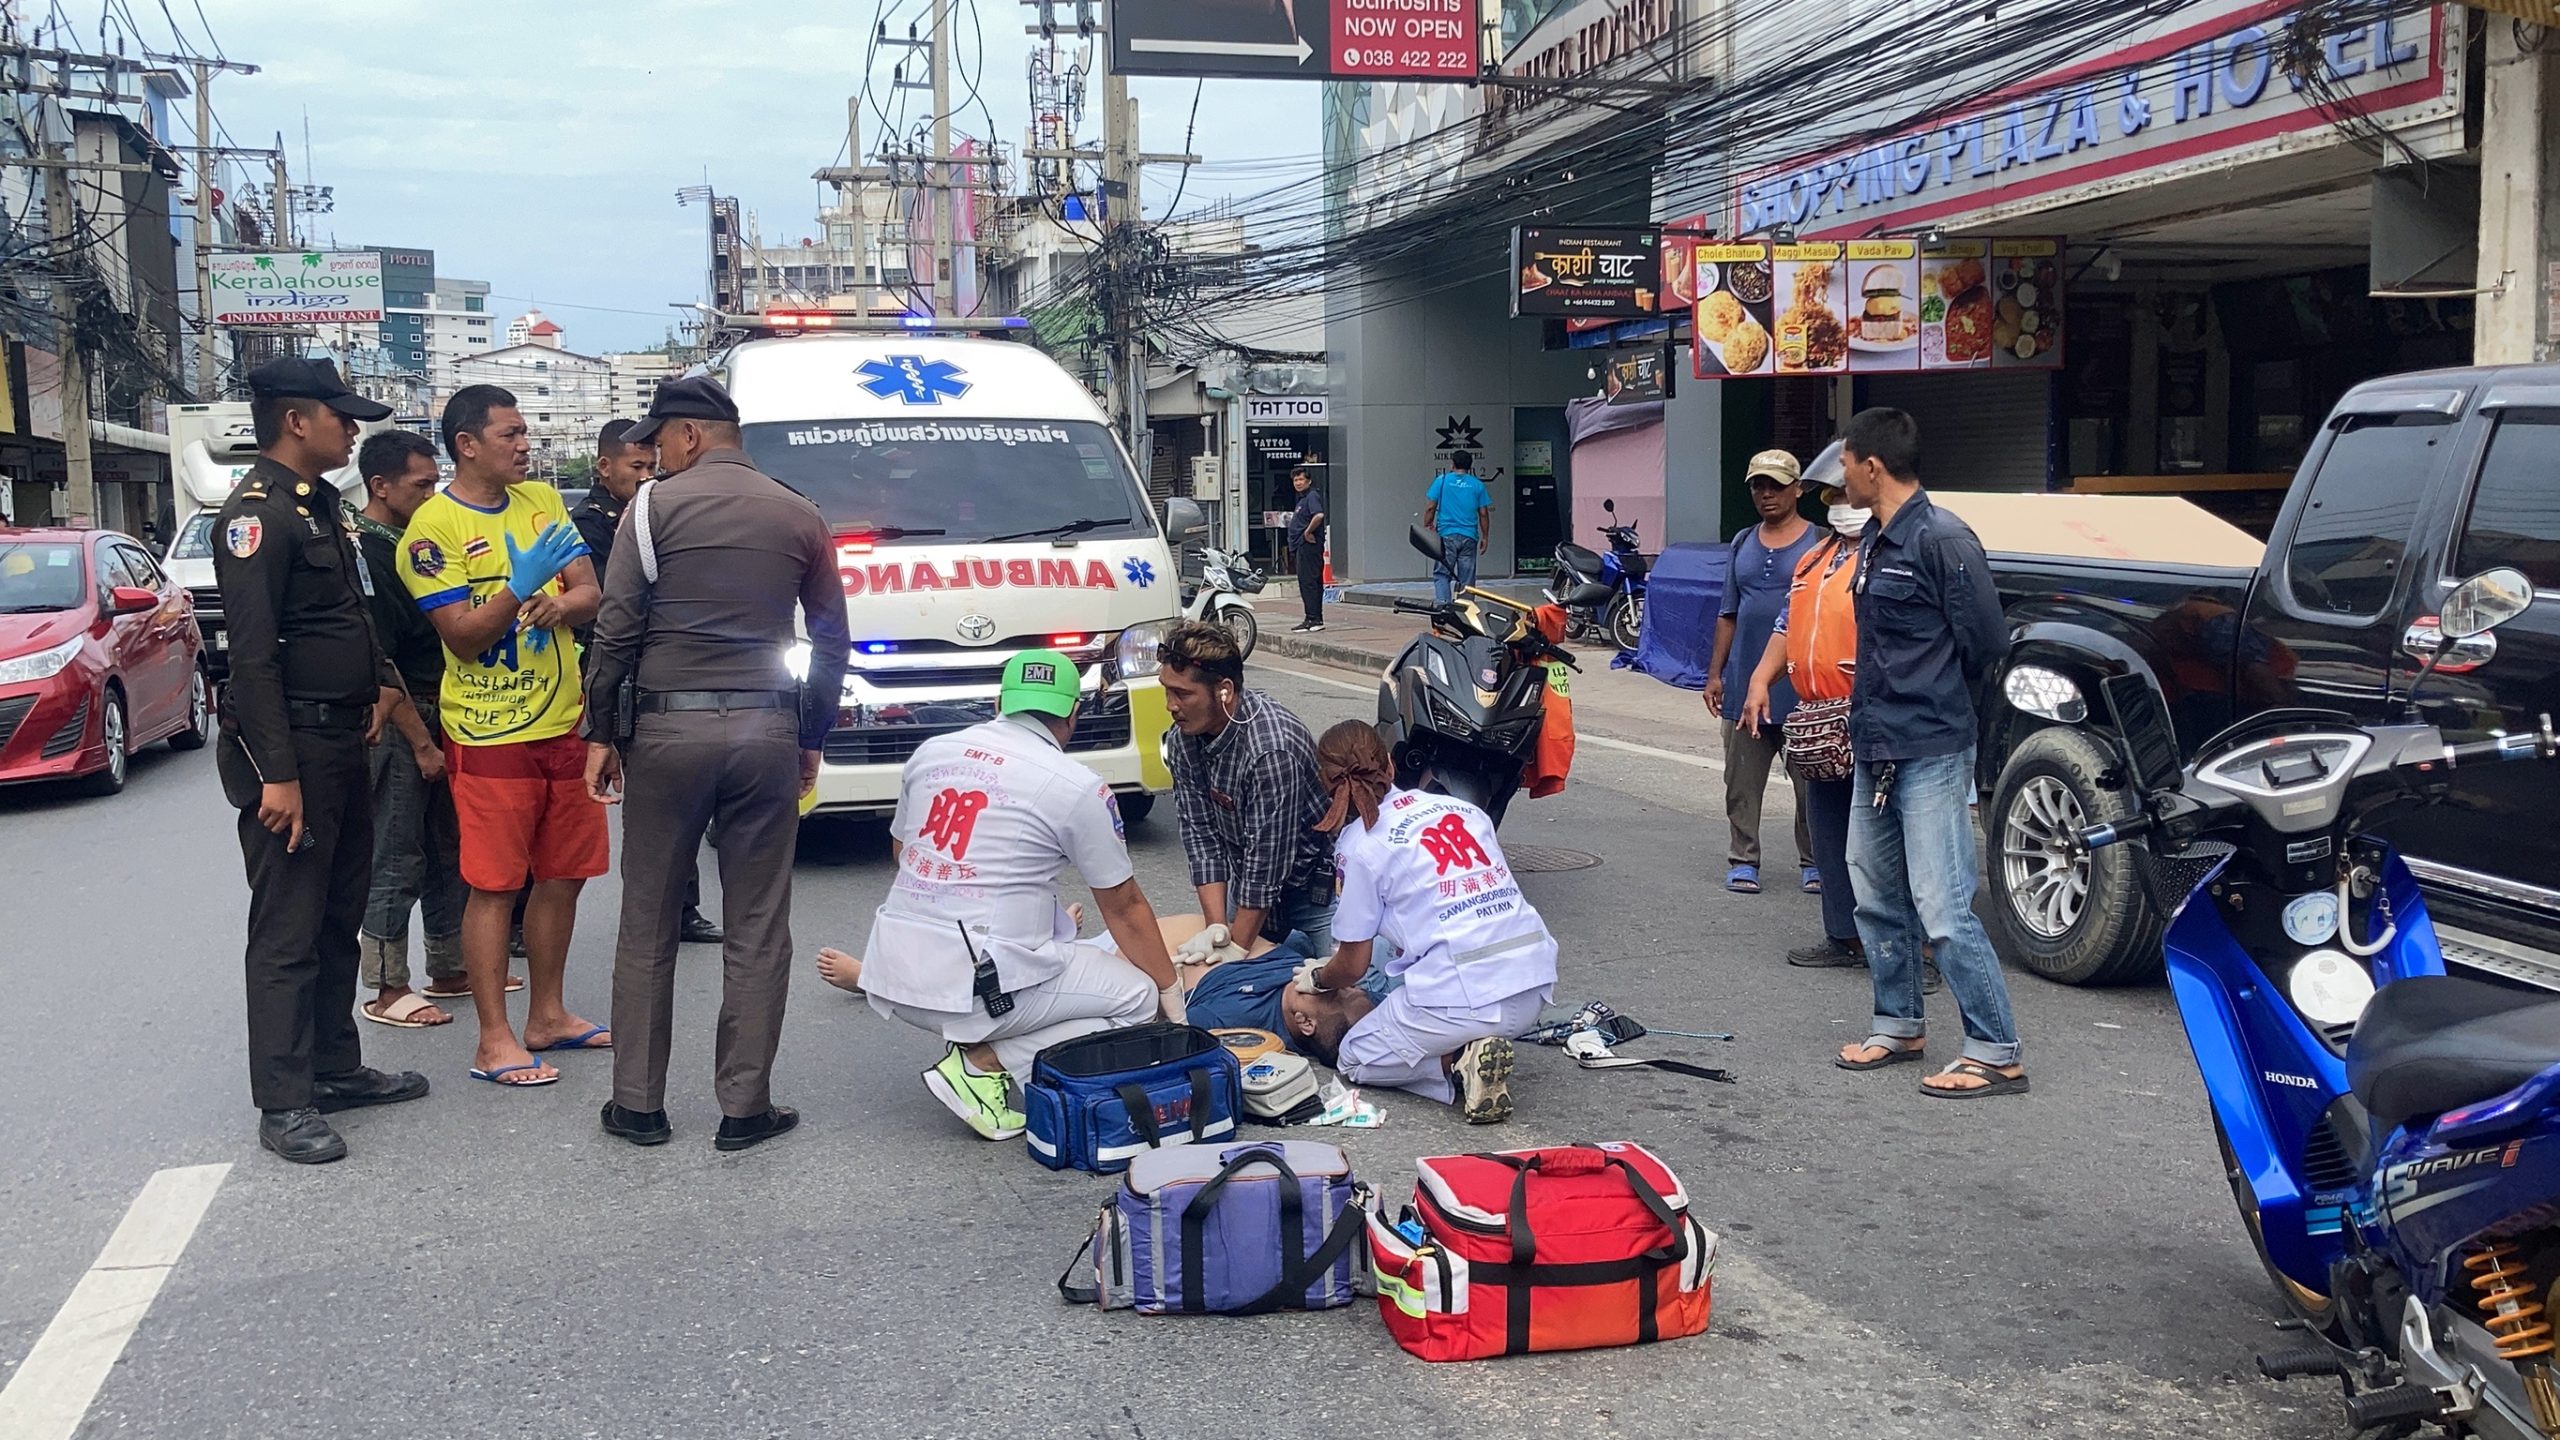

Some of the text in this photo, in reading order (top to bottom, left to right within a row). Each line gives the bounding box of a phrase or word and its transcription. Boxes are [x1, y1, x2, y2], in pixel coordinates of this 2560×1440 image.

[1344, 17, 1463, 39] NOW OPEN
[1363, 50, 1468, 68] 038 422 222
[1741, 132, 1931, 233] SHOPPING
[1941, 83, 2099, 185] PLAZA
[2119, 71, 2151, 135] &
[1698, 246, 1761, 259] Chole Bhature
[1774, 246, 1837, 260] Maggi Masala
[1857, 244, 1903, 256] Vada Pav
[390, 254, 431, 266] HOTEL
[245, 291, 350, 309] indigo
[228, 311, 377, 322] INDIAN RESTAURANT
[1249, 401, 1323, 415] TATTOO
[1253, 439, 1290, 447] TATTOO
[1024, 665, 1054, 682] EMT
[507, 705, 531, 725] 25
[964, 748, 1005, 766] EMT-B
[1393, 795, 1418, 809] EMR
[1476, 901, 1514, 918] PATTAYA
[2264, 1071, 2319, 1089] HONDA
[2407, 1147, 2500, 1180] WAVE
